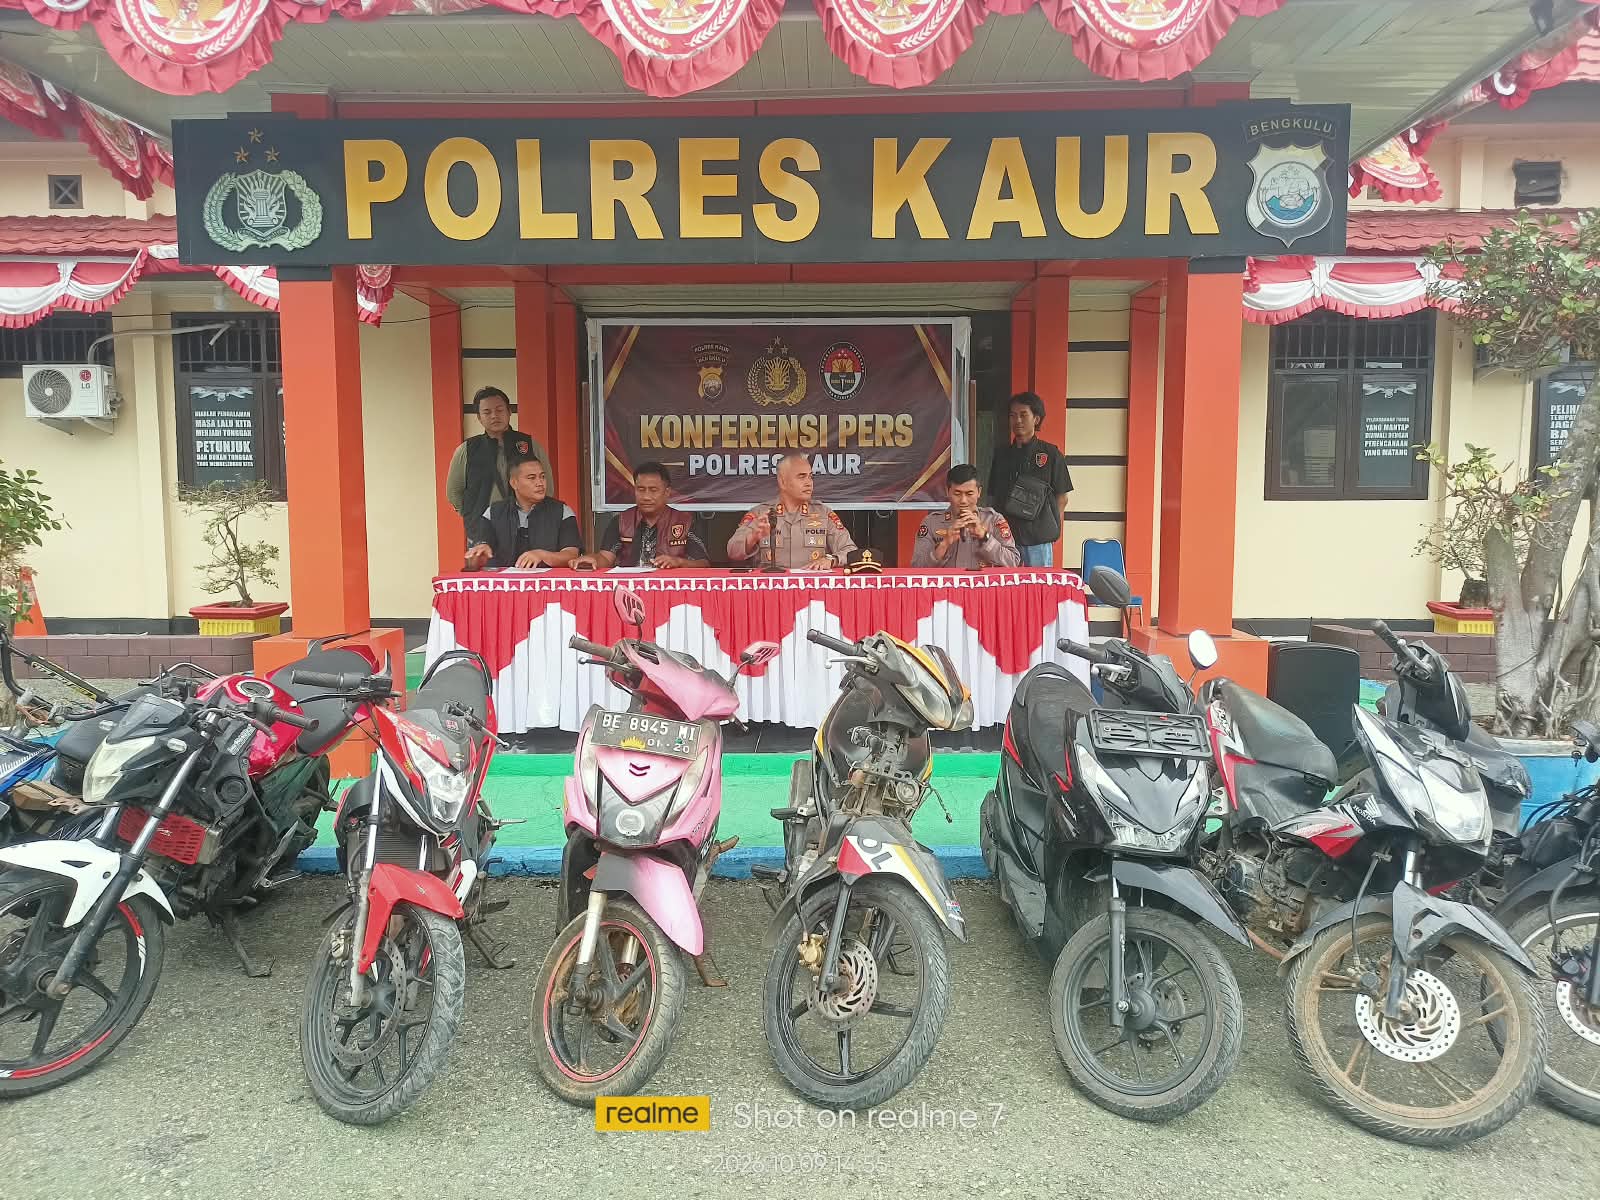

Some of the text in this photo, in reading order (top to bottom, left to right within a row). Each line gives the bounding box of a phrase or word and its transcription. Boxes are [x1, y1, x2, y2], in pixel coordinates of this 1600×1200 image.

[1250, 118, 1333, 136] BENGKULU
[343, 132, 1221, 242] POLRES KAUR
[81, 382, 91, 390] LG
[195, 419, 252, 428] MASA LALU KITA
[1365, 423, 1410, 431] YANG MANTAP
[639, 413, 914, 450] KONFERENSI PERS
[196, 440, 251, 453] PETUNJUK
[1364, 439, 1408, 448] PERENCANAAN
[1364, 448, 1408, 457] YANG MATANG
[689, 454, 862, 476] POLRES AUR
[602, 714, 622, 729] BE
[629, 717, 671, 735] 8945
[1353, 804, 1377, 826] HONDA
